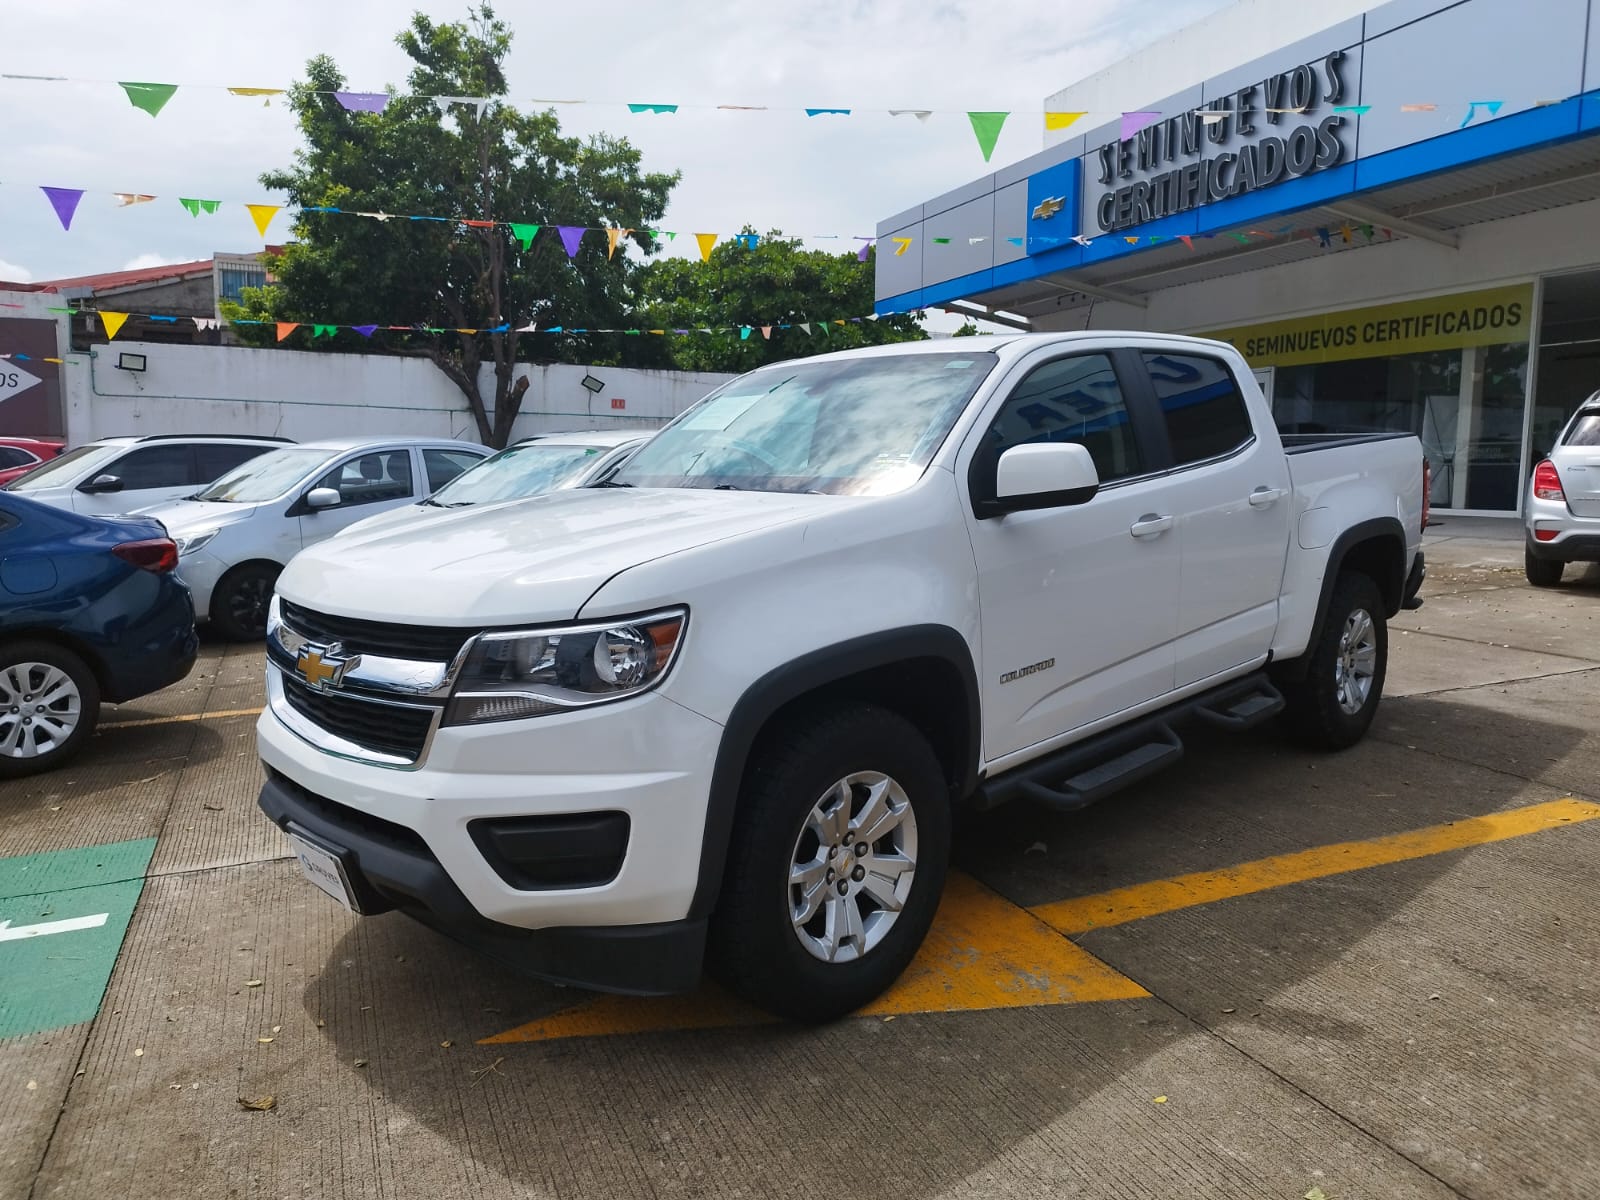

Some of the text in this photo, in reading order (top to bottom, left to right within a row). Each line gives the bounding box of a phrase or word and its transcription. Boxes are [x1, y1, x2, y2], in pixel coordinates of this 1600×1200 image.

[1097, 50, 1347, 184] SEMINUEVOS
[1097, 115, 1347, 232] CERTIFICADOS
[1246, 302, 1522, 358] SEMINUEVOS CERTIFICADOS
